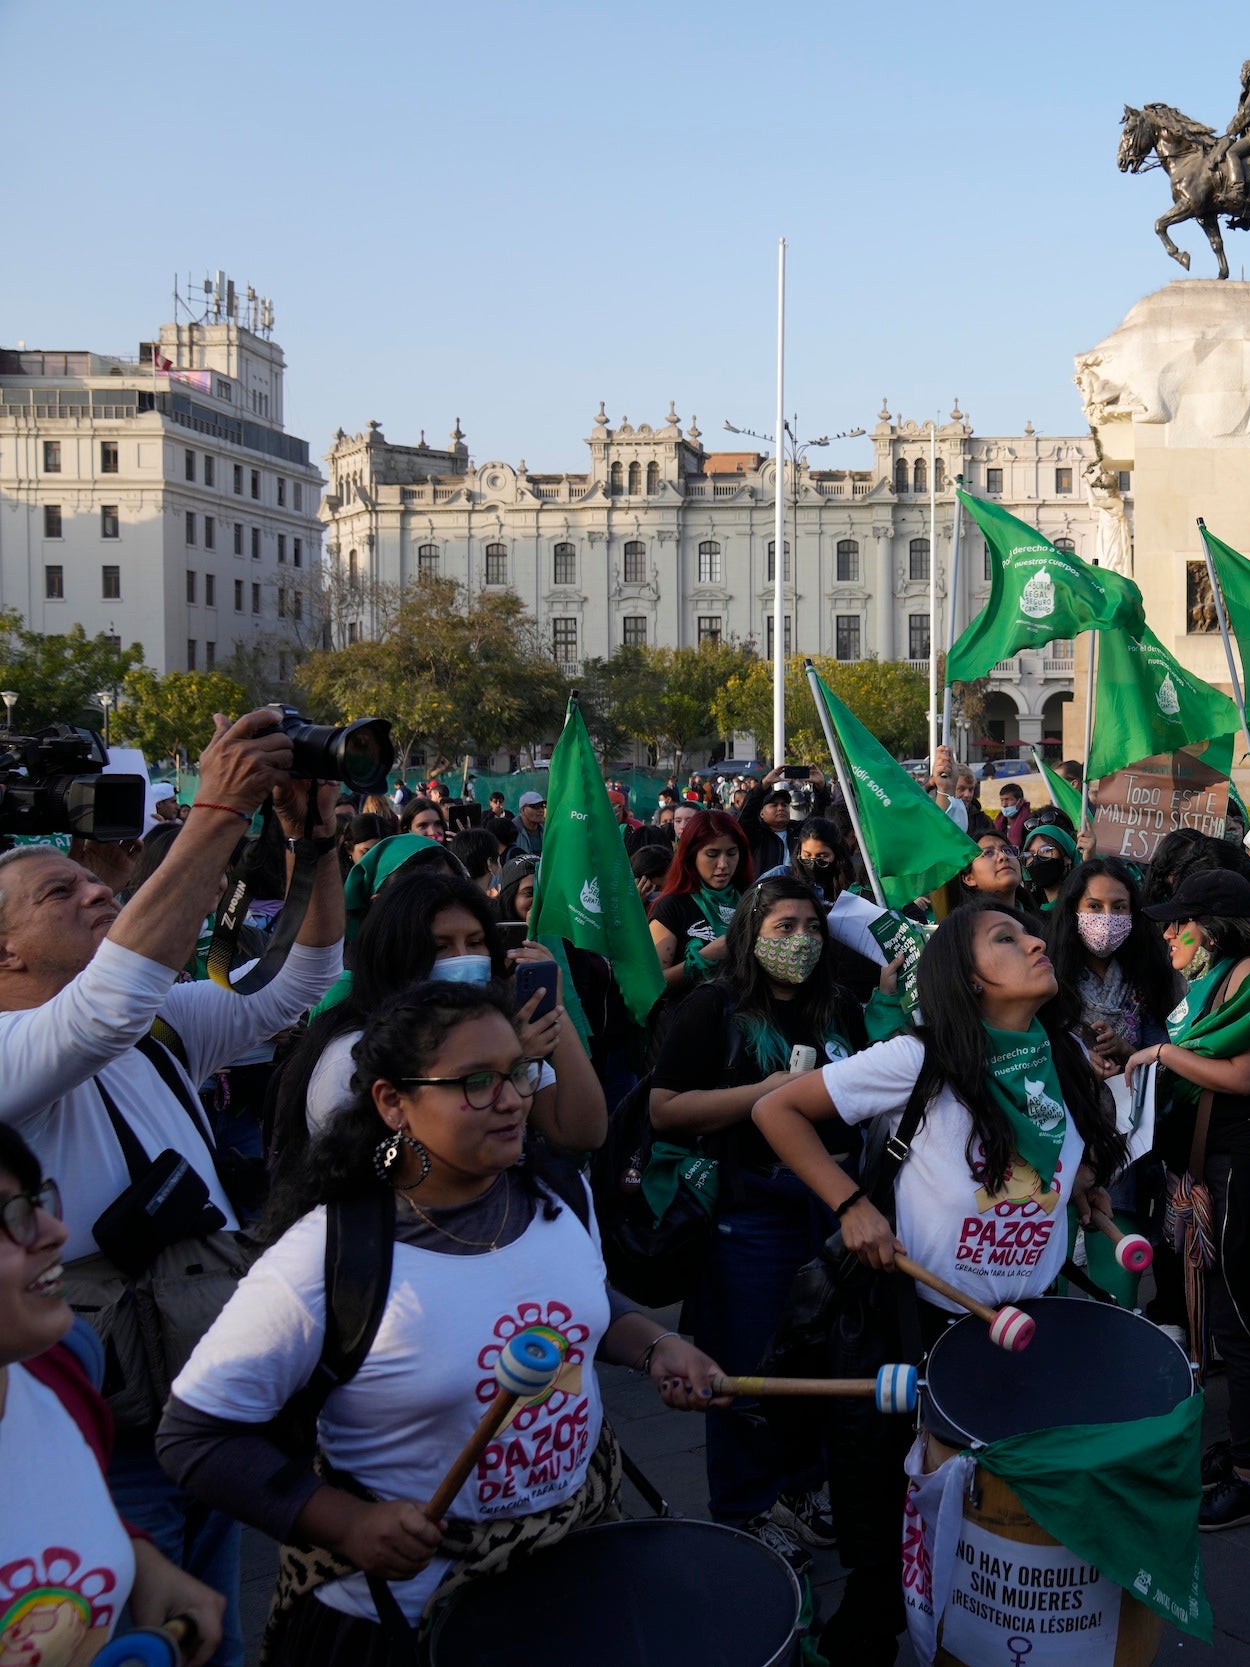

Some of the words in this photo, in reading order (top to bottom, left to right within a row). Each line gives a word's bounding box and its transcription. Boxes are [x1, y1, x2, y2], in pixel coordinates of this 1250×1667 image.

[1012, 544, 1048, 555] derecho
[1014, 558, 1048, 568] nuestros
[1048, 558, 1080, 577] cuerpos
[867, 779, 892, 807] sobre
[1124, 774, 1161, 806] TODO
[1169, 787, 1218, 814] ESTE
[570, 810, 588, 822] Por
[1097, 803, 1164, 829] MALDITO
[1169, 810, 1226, 839] SISTEMA
[227, 879, 247, 914] Nikon
[220, 912, 237, 931] Z
[990, 1046, 1028, 1065] derecho
[1030, 1046, 1036, 1054] a
[960, 1217, 1056, 1249] PAZOS
[956, 1245, 985, 1264] DE
[954, 1263, 989, 1277] CREACIÓN
[477, 1397, 589, 1481] PAZOS
[479, 1476, 517, 1503] DE
[531, 1484, 555, 1500] PARA
[557, 1480, 569, 1491] LA
[956, 1539, 975, 1565] NO
[979, 1551, 1014, 1583] HAY
[1018, 1565, 1100, 1589] ORGULLO
[906, 1595, 916, 1607] LA
[970, 1571, 997, 1601] SIN
[1002, 1590, 1084, 1612] MUJERES
[951, 1589, 1036, 1634] ¡RESISTENCIA
[1040, 1611, 1103, 1635] LÉSBICA!
